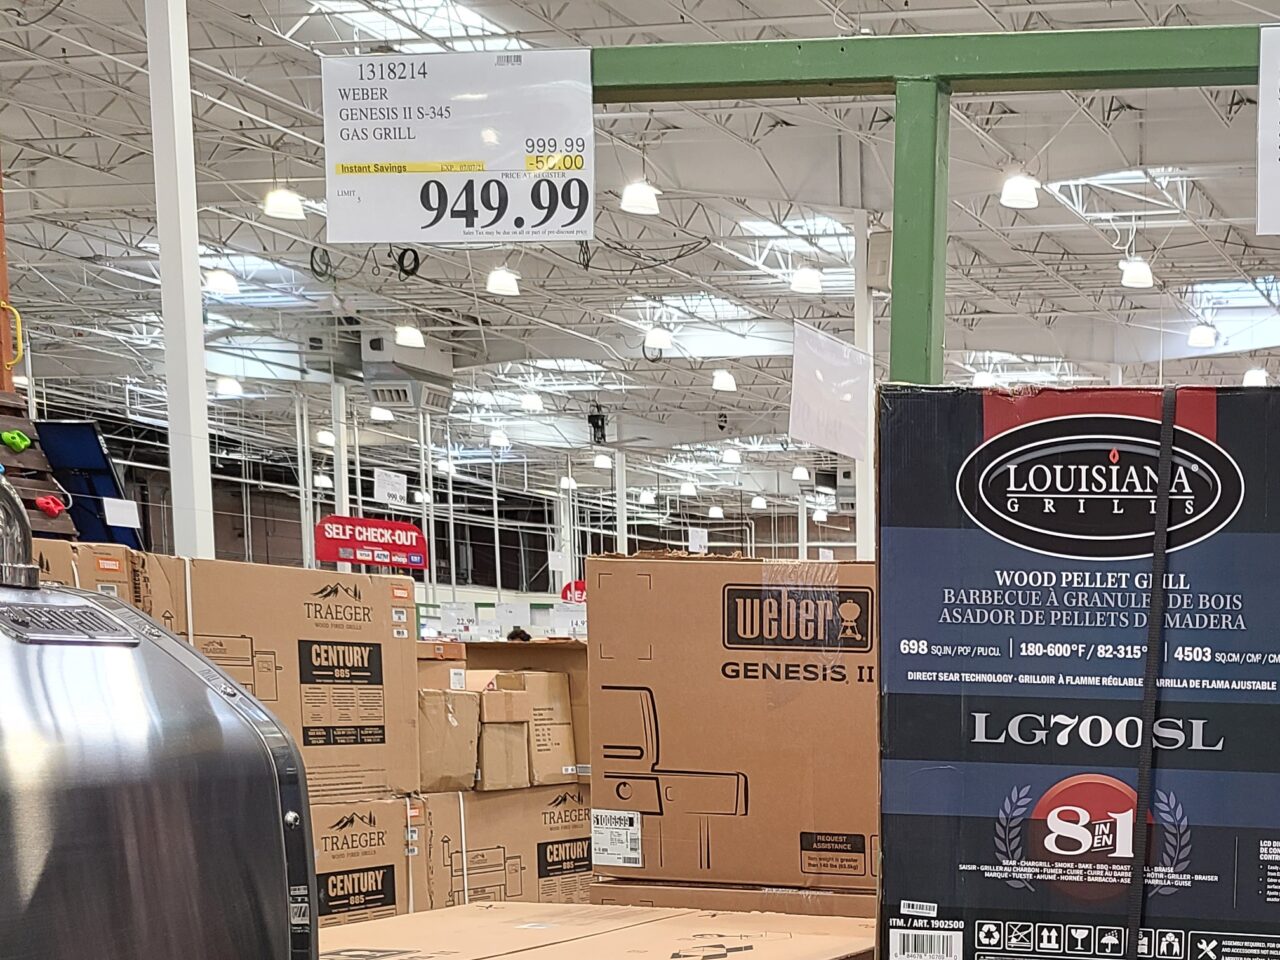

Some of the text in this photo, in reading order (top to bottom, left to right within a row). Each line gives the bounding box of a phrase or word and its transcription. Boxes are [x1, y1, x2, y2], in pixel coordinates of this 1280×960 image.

[358, 62, 427, 80] 1318214
[339, 88, 388, 100] WEBER
[340, 106, 451, 121] GENESIS II S-345
[340, 127, 416, 140] GAS GRILL
[526, 138, 585, 153] 999.99
[341, 164, 370, 173] Instant
[374, 163, 406, 173] Savings
[529, 155, 584, 170] -50.00
[420, 178, 589, 230] 949.99
[1006, 465, 1193, 493] LOUISIANA
[325, 524, 418, 546] SELF CHECK-OUT
[995, 571, 1189, 590] WOOD PELLET GILL
[943, 588, 1242, 610] BARBECUE À GRANULE DE BOIS
[304, 602, 372, 622] TRAEGER
[735, 589, 833, 641] weber
[938, 608, 1246, 630] ASADOR DE PELLETS D MADERA
[312, 644, 370, 668] CENTURY
[900, 640, 928, 654] 698
[1097, 645, 1147, 659] 82-315°
[1174, 646, 1212, 662] 4503
[335, 669, 350, 678] 885
[721, 662, 874, 683] GENESIS II
[908, 671, 1277, 690] DIRECT SEAR TECHNOLOGY GRILLOIR À FLAMME RÉGLABLE RRILLA DE FLAMA AJUSTABLE
[971, 712, 1225, 752] LG700SL
[542, 808, 590, 825] TRAEGER
[321, 831, 385, 852] TRAEGER
[1044, 805, 1134, 858] 8 IN EN 1
[547, 841, 589, 862] CENTURY
[328, 870, 384, 897] CENTURY
[350, 895, 365, 905] 885
[890, 918, 964, 928] ITM. ART. 1902500
